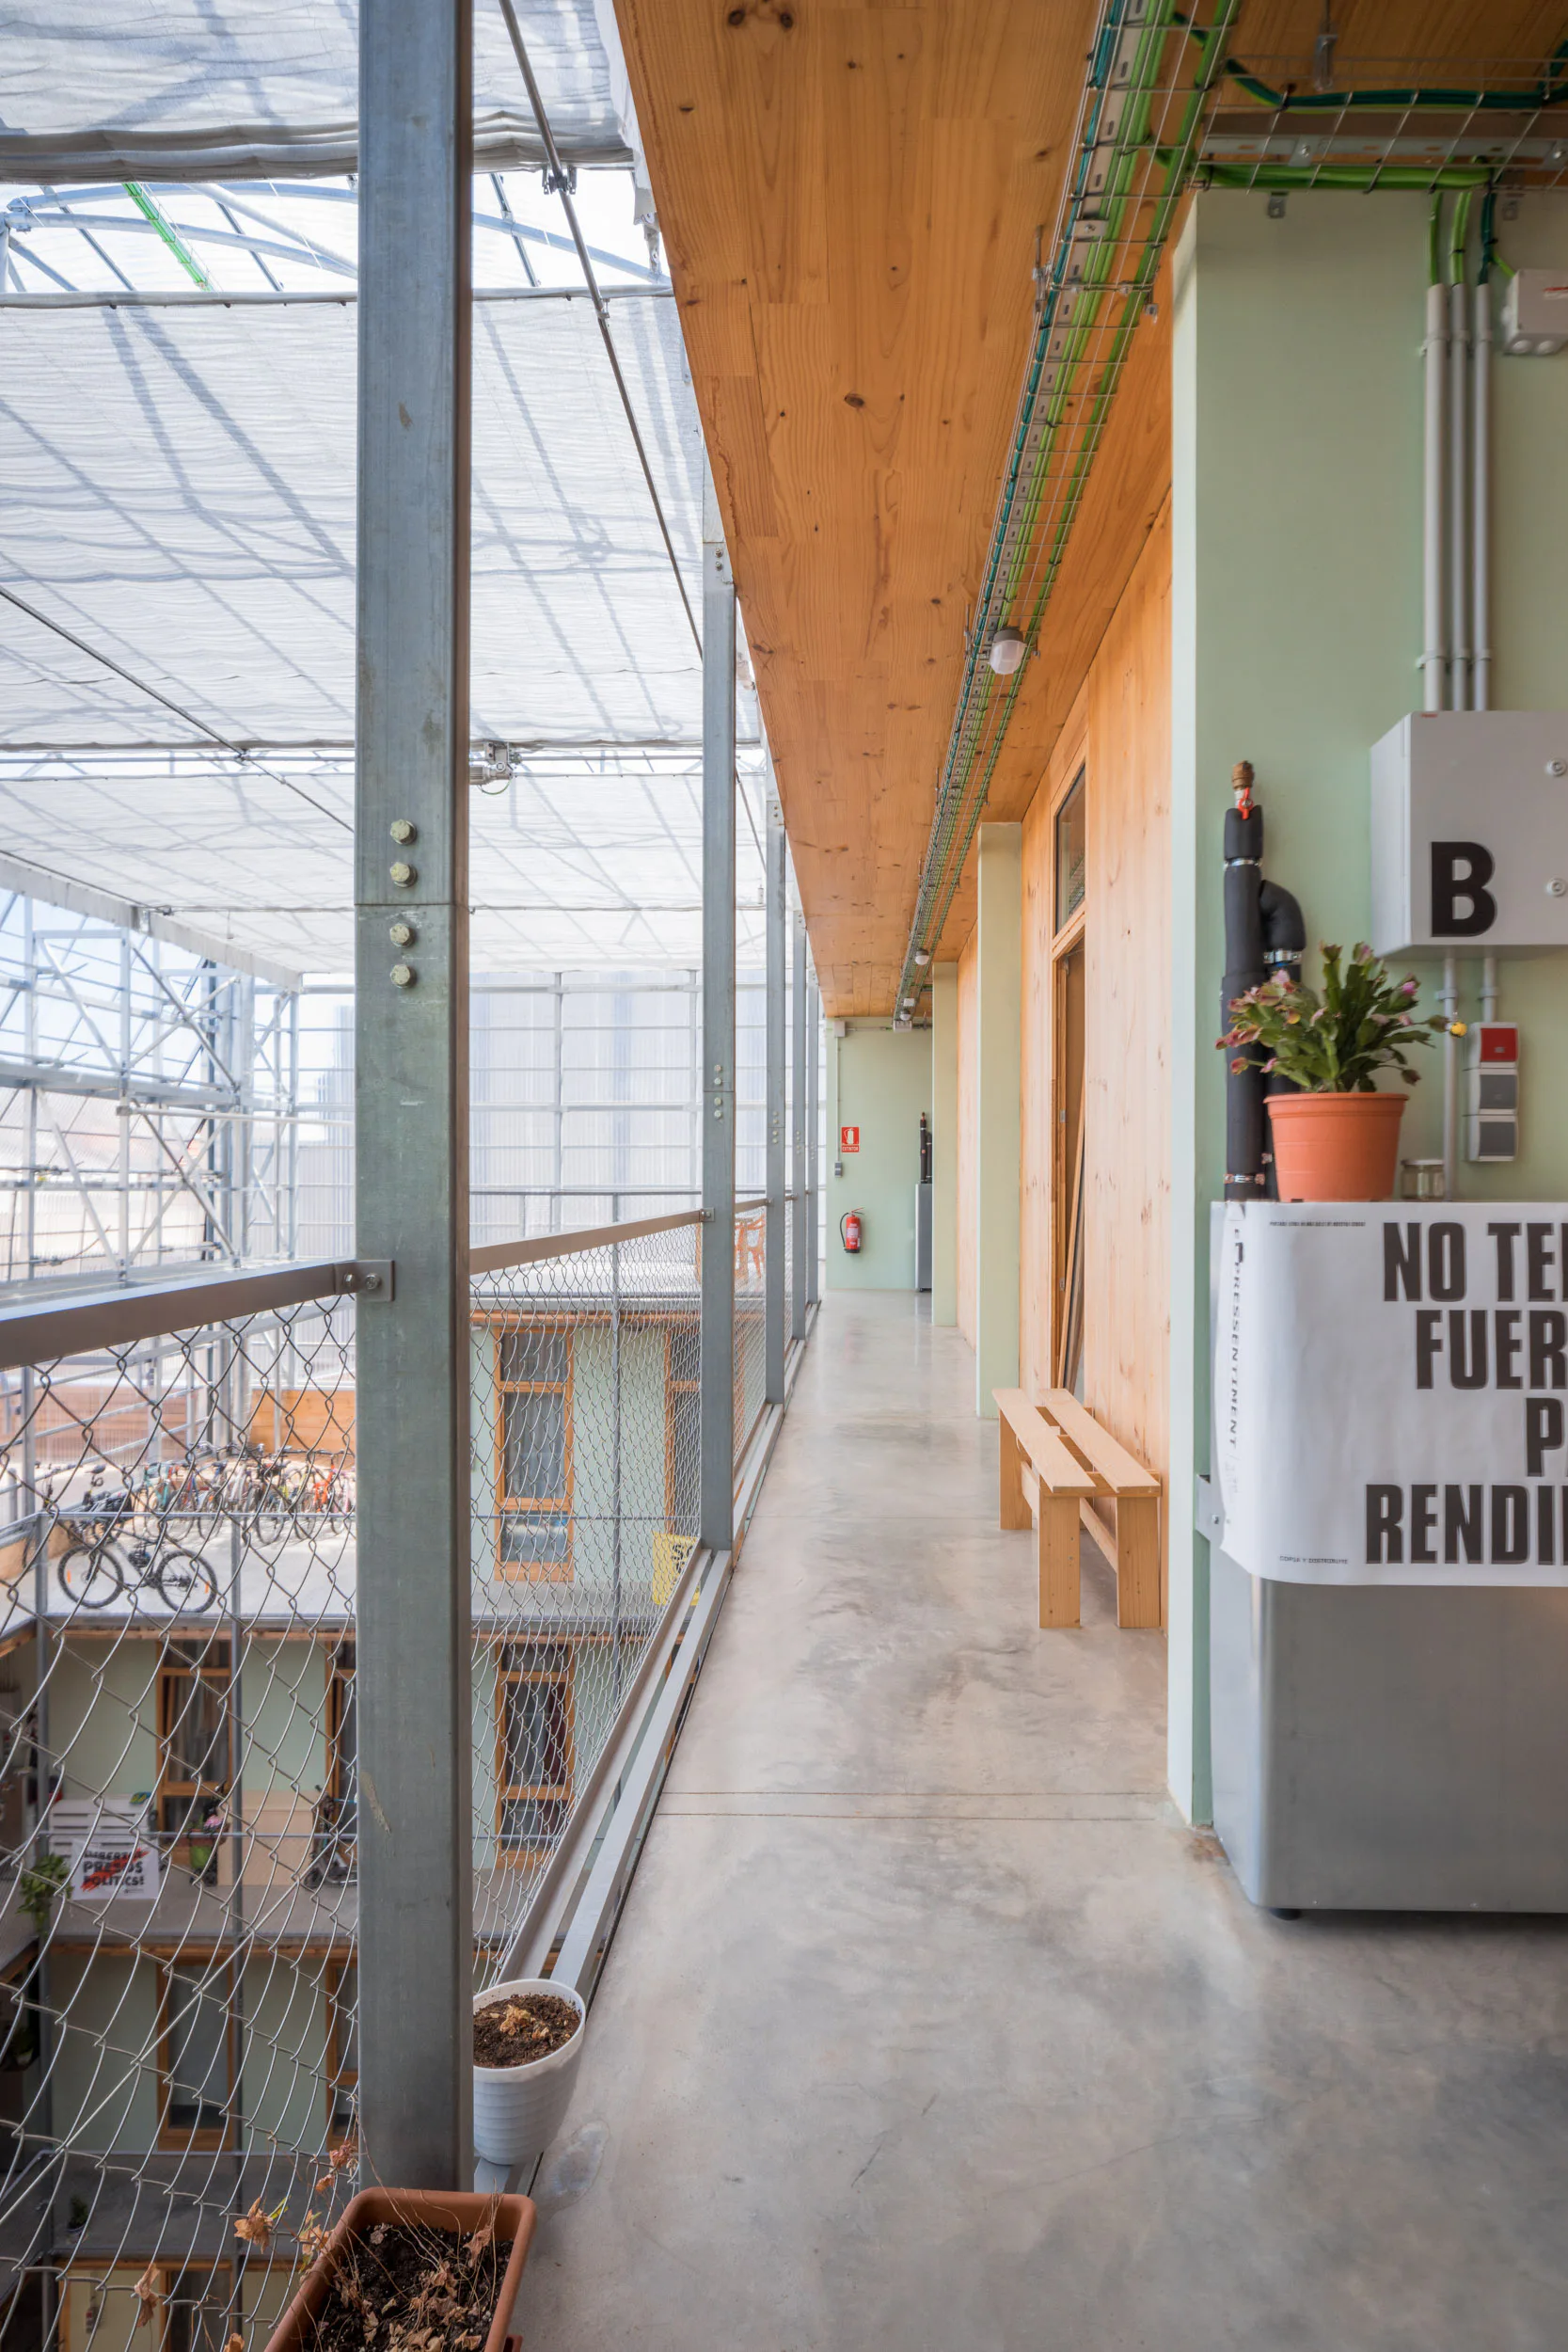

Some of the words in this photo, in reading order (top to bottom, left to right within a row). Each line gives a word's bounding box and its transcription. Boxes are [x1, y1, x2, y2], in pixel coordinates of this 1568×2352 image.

[1431, 841, 1497, 937] B
[1384, 1222, 1465, 1302] NO
[1417, 1310, 1567, 1390] FUER
[1366, 1485, 1568, 1565] RENDI
